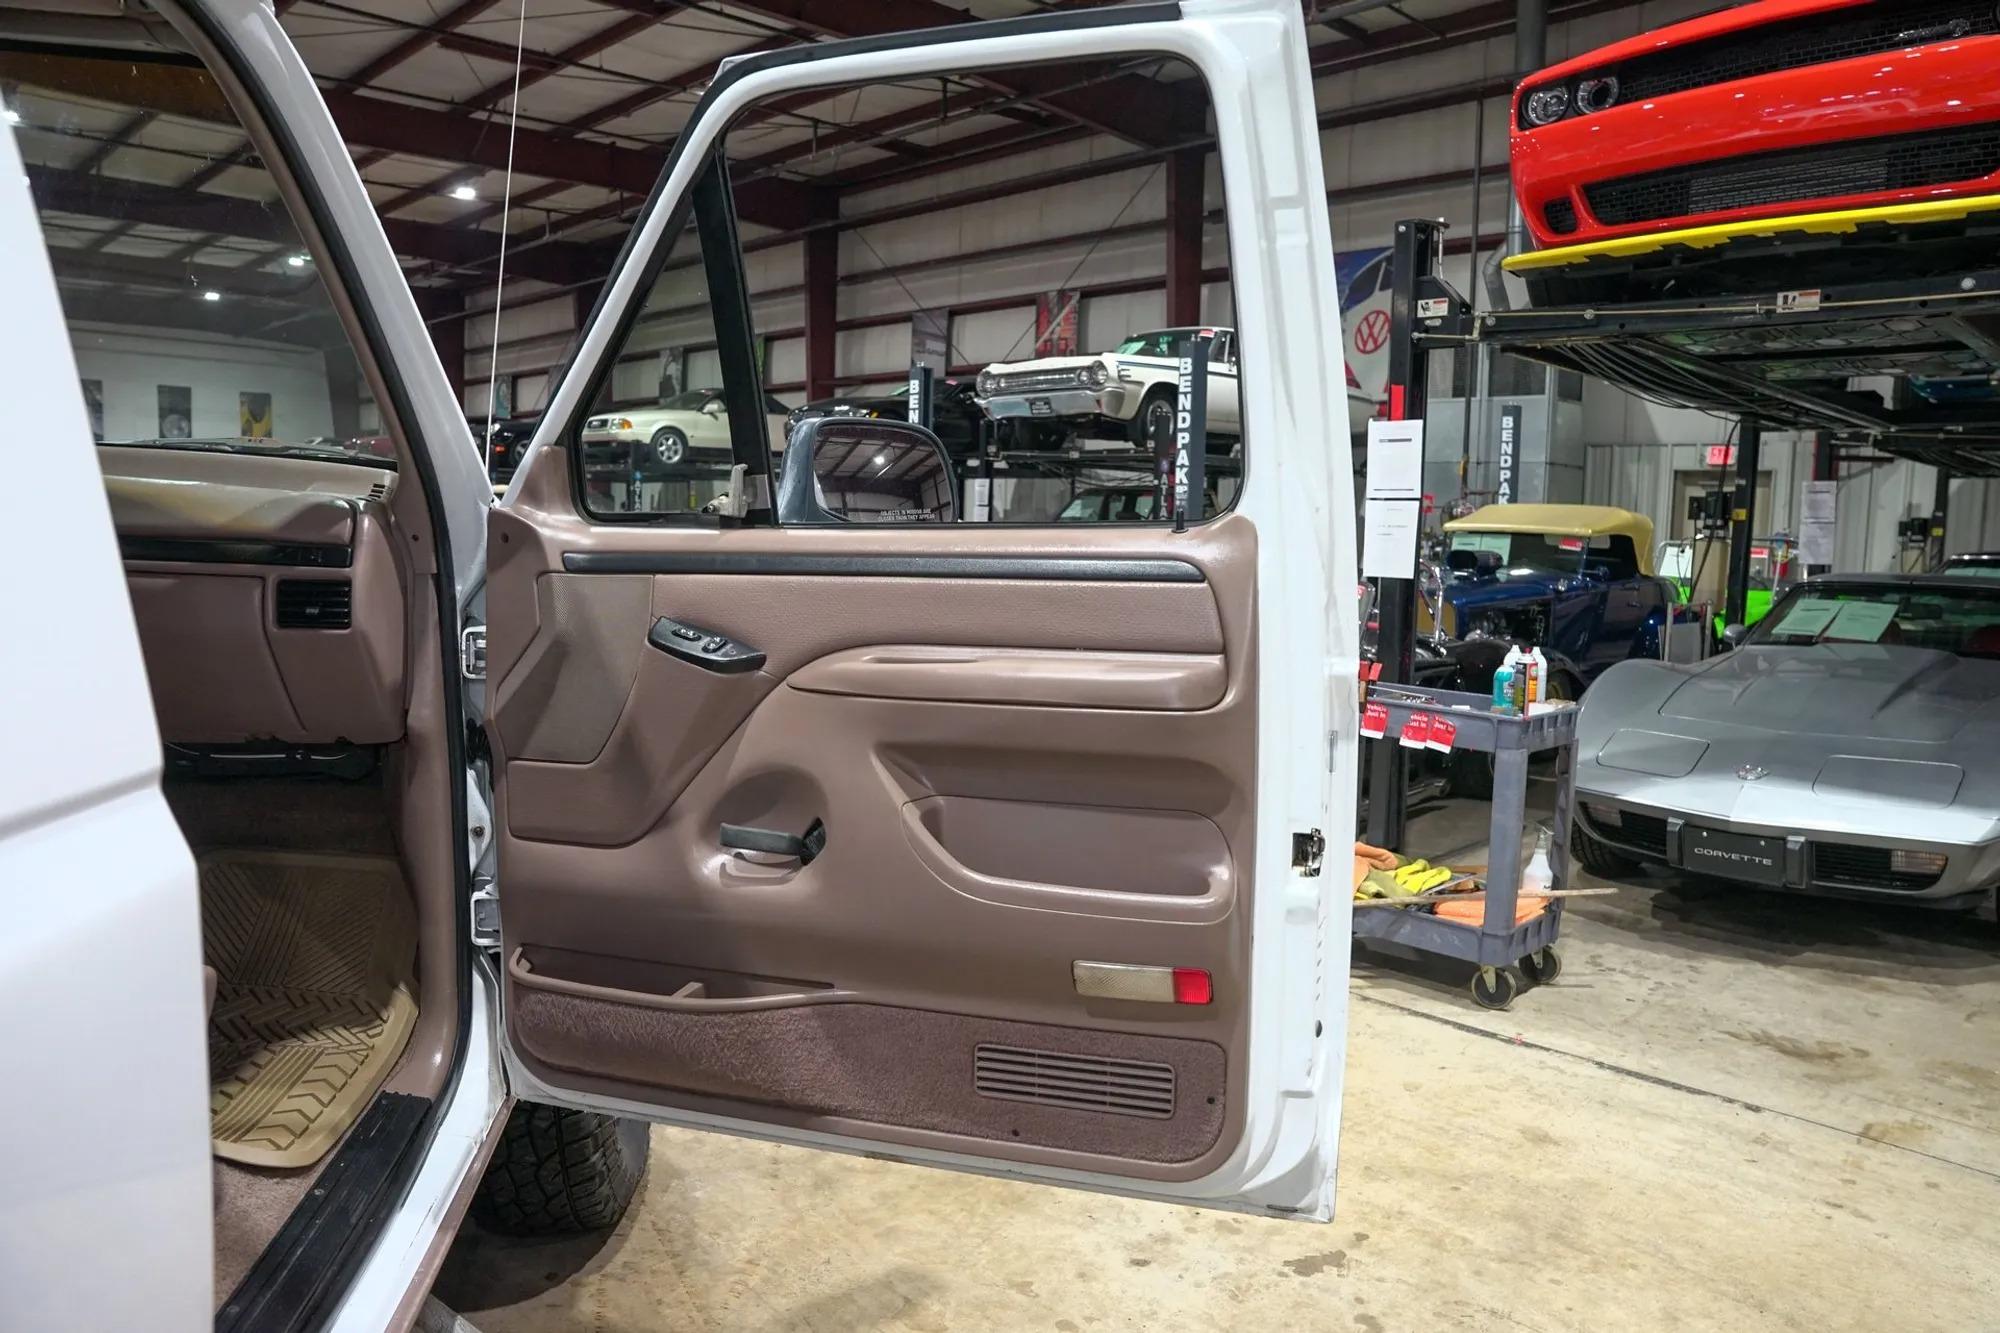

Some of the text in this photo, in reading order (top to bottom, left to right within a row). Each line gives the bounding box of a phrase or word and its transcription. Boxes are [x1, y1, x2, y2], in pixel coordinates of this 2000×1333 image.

[1174, 357, 1192, 484] BENDPAK
[1159, 473, 1169, 520] ATLA
[1409, 714, 1429, 722] ehicle
[1694, 847, 1773, 866] CORVETTE
